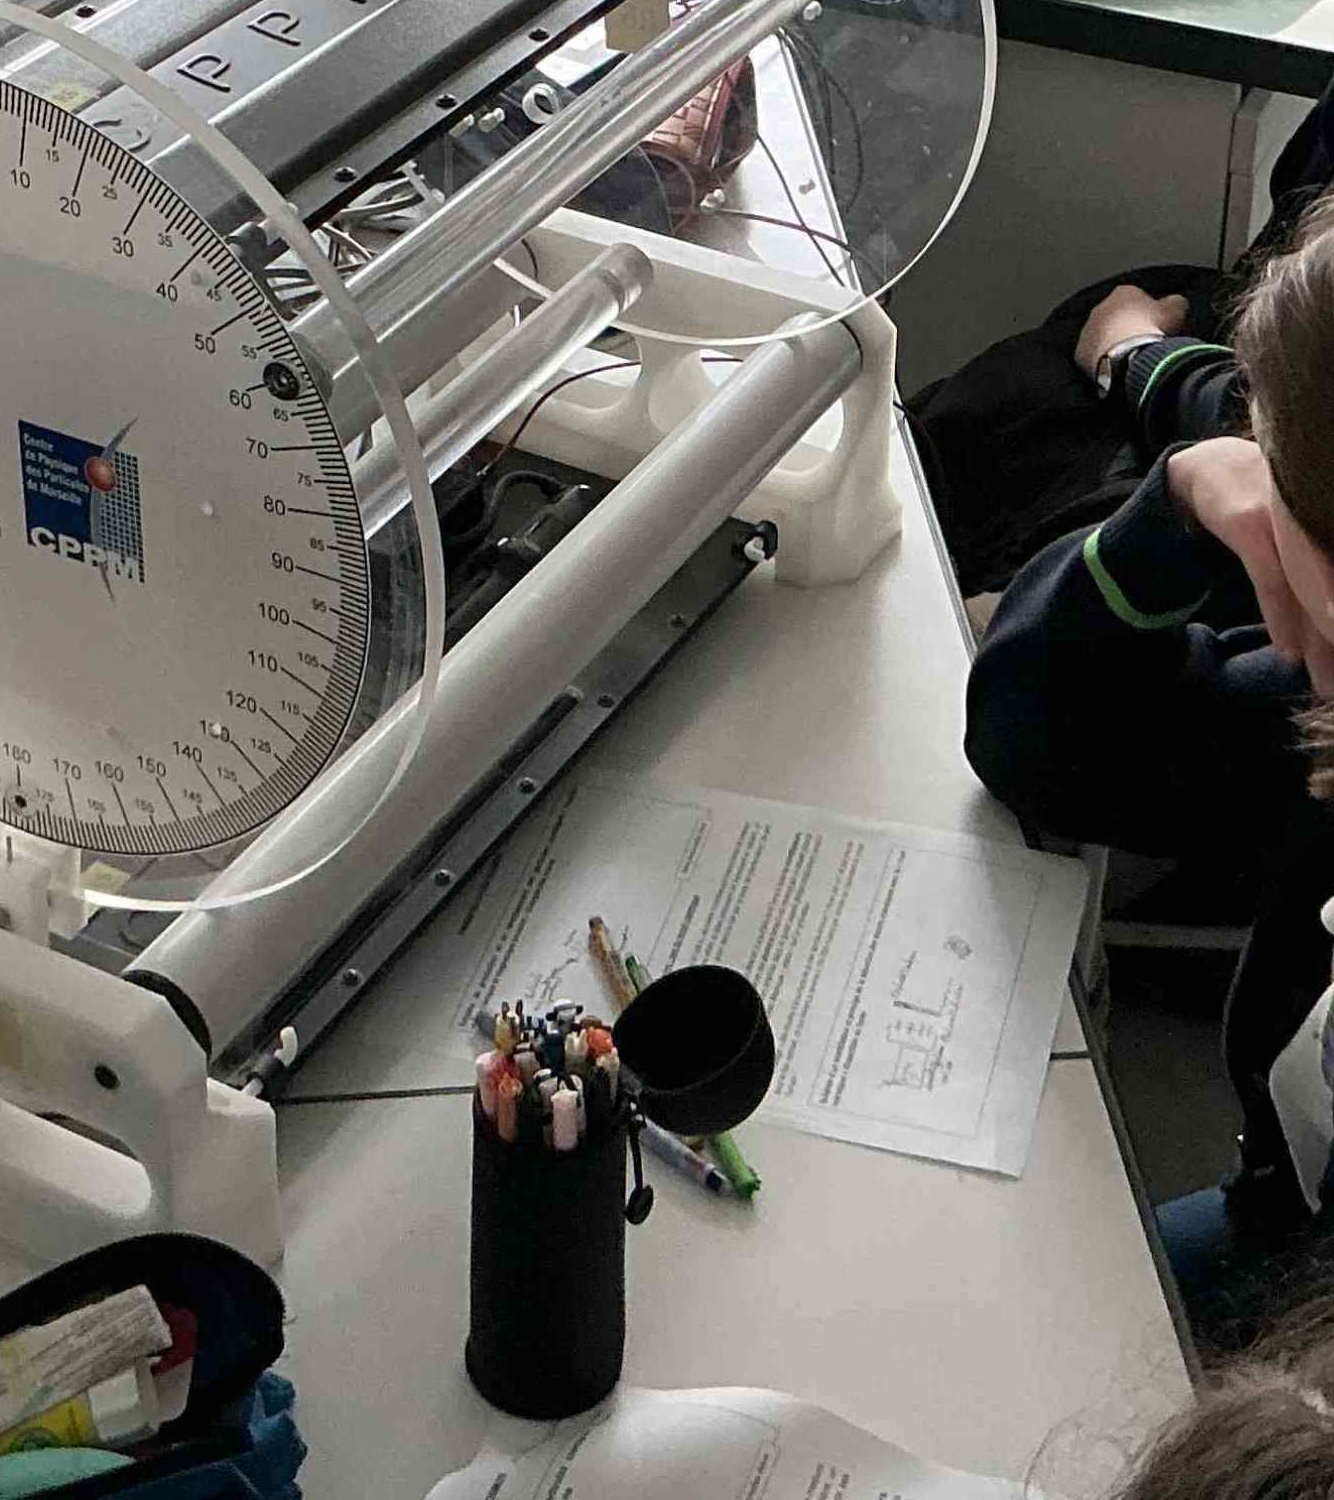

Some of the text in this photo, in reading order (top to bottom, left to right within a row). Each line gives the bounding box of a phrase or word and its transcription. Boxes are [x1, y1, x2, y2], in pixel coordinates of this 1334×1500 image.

[46, 149, 60, 163] 15
[10, 169, 31, 189] 10
[101, 185, 117, 200] 25
[59, 197, 81, 217] 20
[112, 237, 135, 257] 30
[157, 233, 173, 248] 35
[156, 282, 178, 302] 40
[206, 287, 222, 301] 45
[194, 333, 216, 354] 50
[242, 345, 257, 360] 55
[230, 389, 251, 409] 60
[273, 408, 289, 422] 65
[246, 438, 268, 459] 70
[297, 472, 312, 487] 75
[263, 495, 286, 516] 80
[30, 526, 142, 582] CPPM
[271, 552, 294, 573] 90
[258, 603, 290, 625] 100
[247, 650, 278, 672] 110
[298, 651, 319, 668] 105
[226, 690, 257, 713] 120
[281, 701, 299, 716] 115
[172, 741, 202, 763] 140
[251, 738, 271, 754] 125
[53, 758, 82, 780] 170
[136, 754, 166, 777] 150
